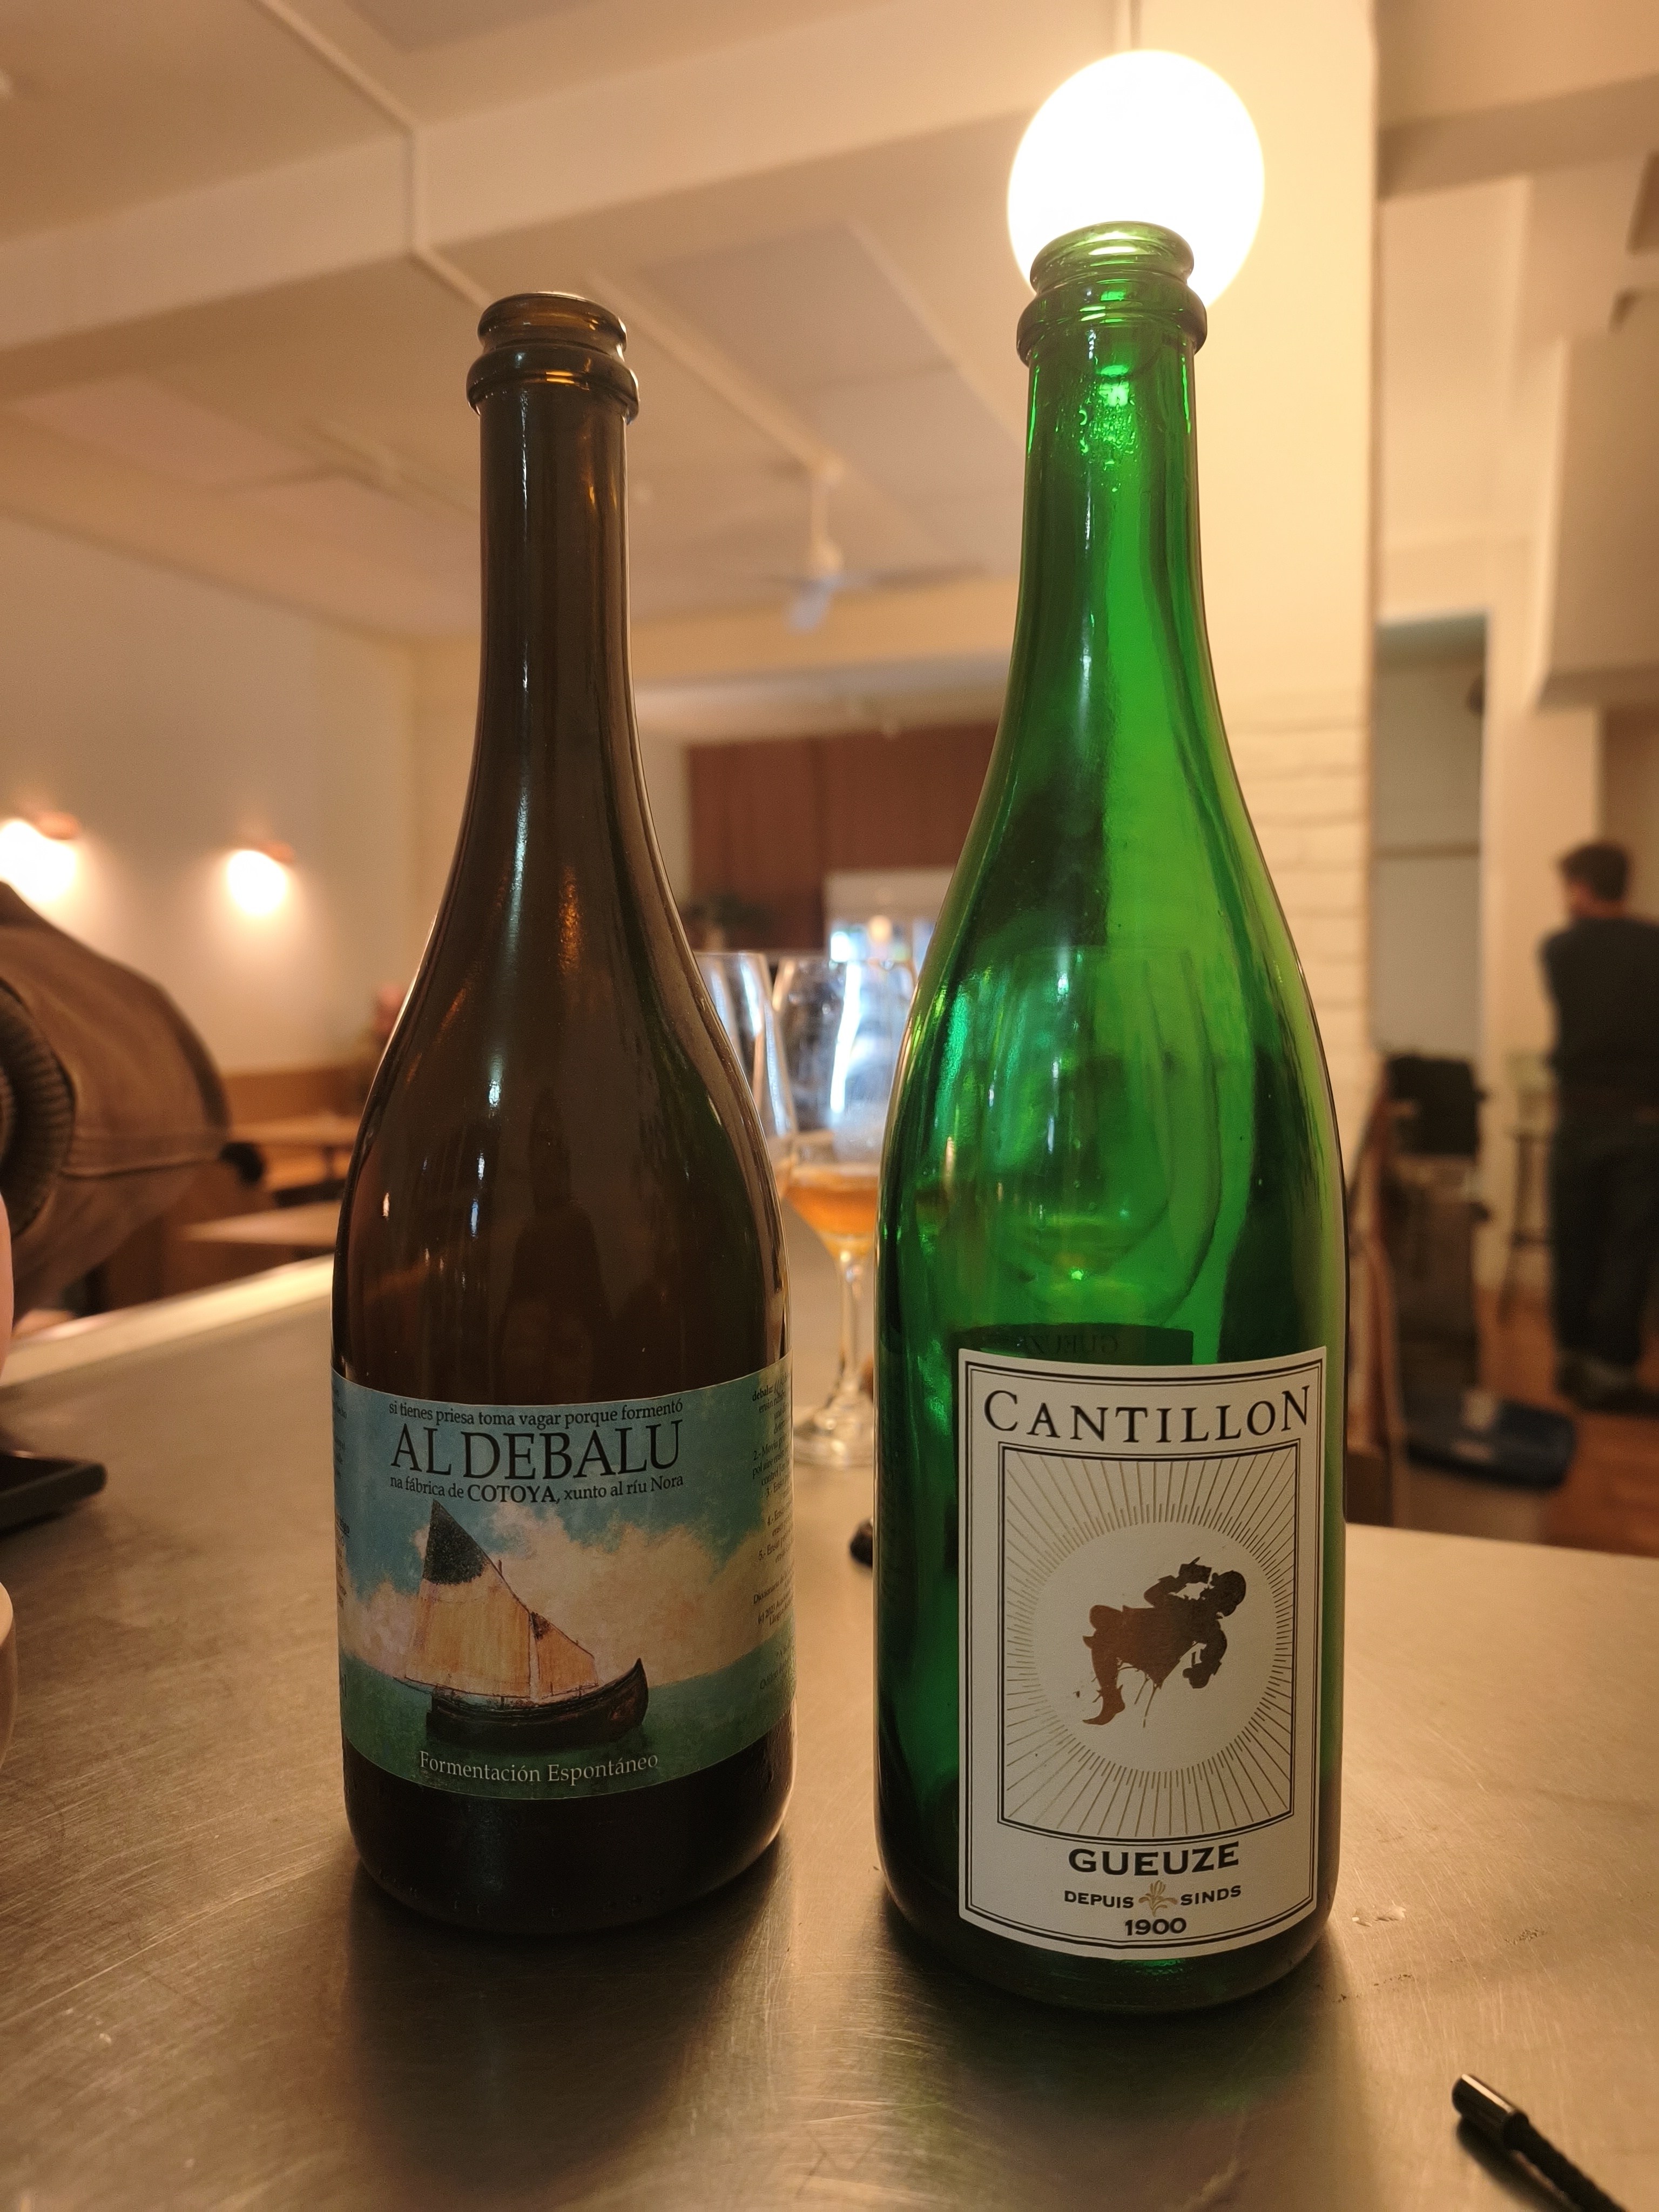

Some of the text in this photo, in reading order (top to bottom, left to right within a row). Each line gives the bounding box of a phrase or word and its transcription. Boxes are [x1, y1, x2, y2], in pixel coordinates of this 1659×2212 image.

[389, 1398, 683, 1431] si tienes priesa toma vagar porque formentó
[984, 1385, 1310, 1444] CANTILLON
[390, 1419, 683, 1480] AL DEBALU
[390, 1475, 684, 1505] na fábrica de COTOYA, xunto al ríu Nora
[419, 1750, 658, 1786] Formentación Espontáneo
[1068, 1840, 1239, 1876] GUEUZE
[1064, 1885, 1242, 1909] DEPUIS SINDS
[1124, 1917, 1186, 1936] 1900
